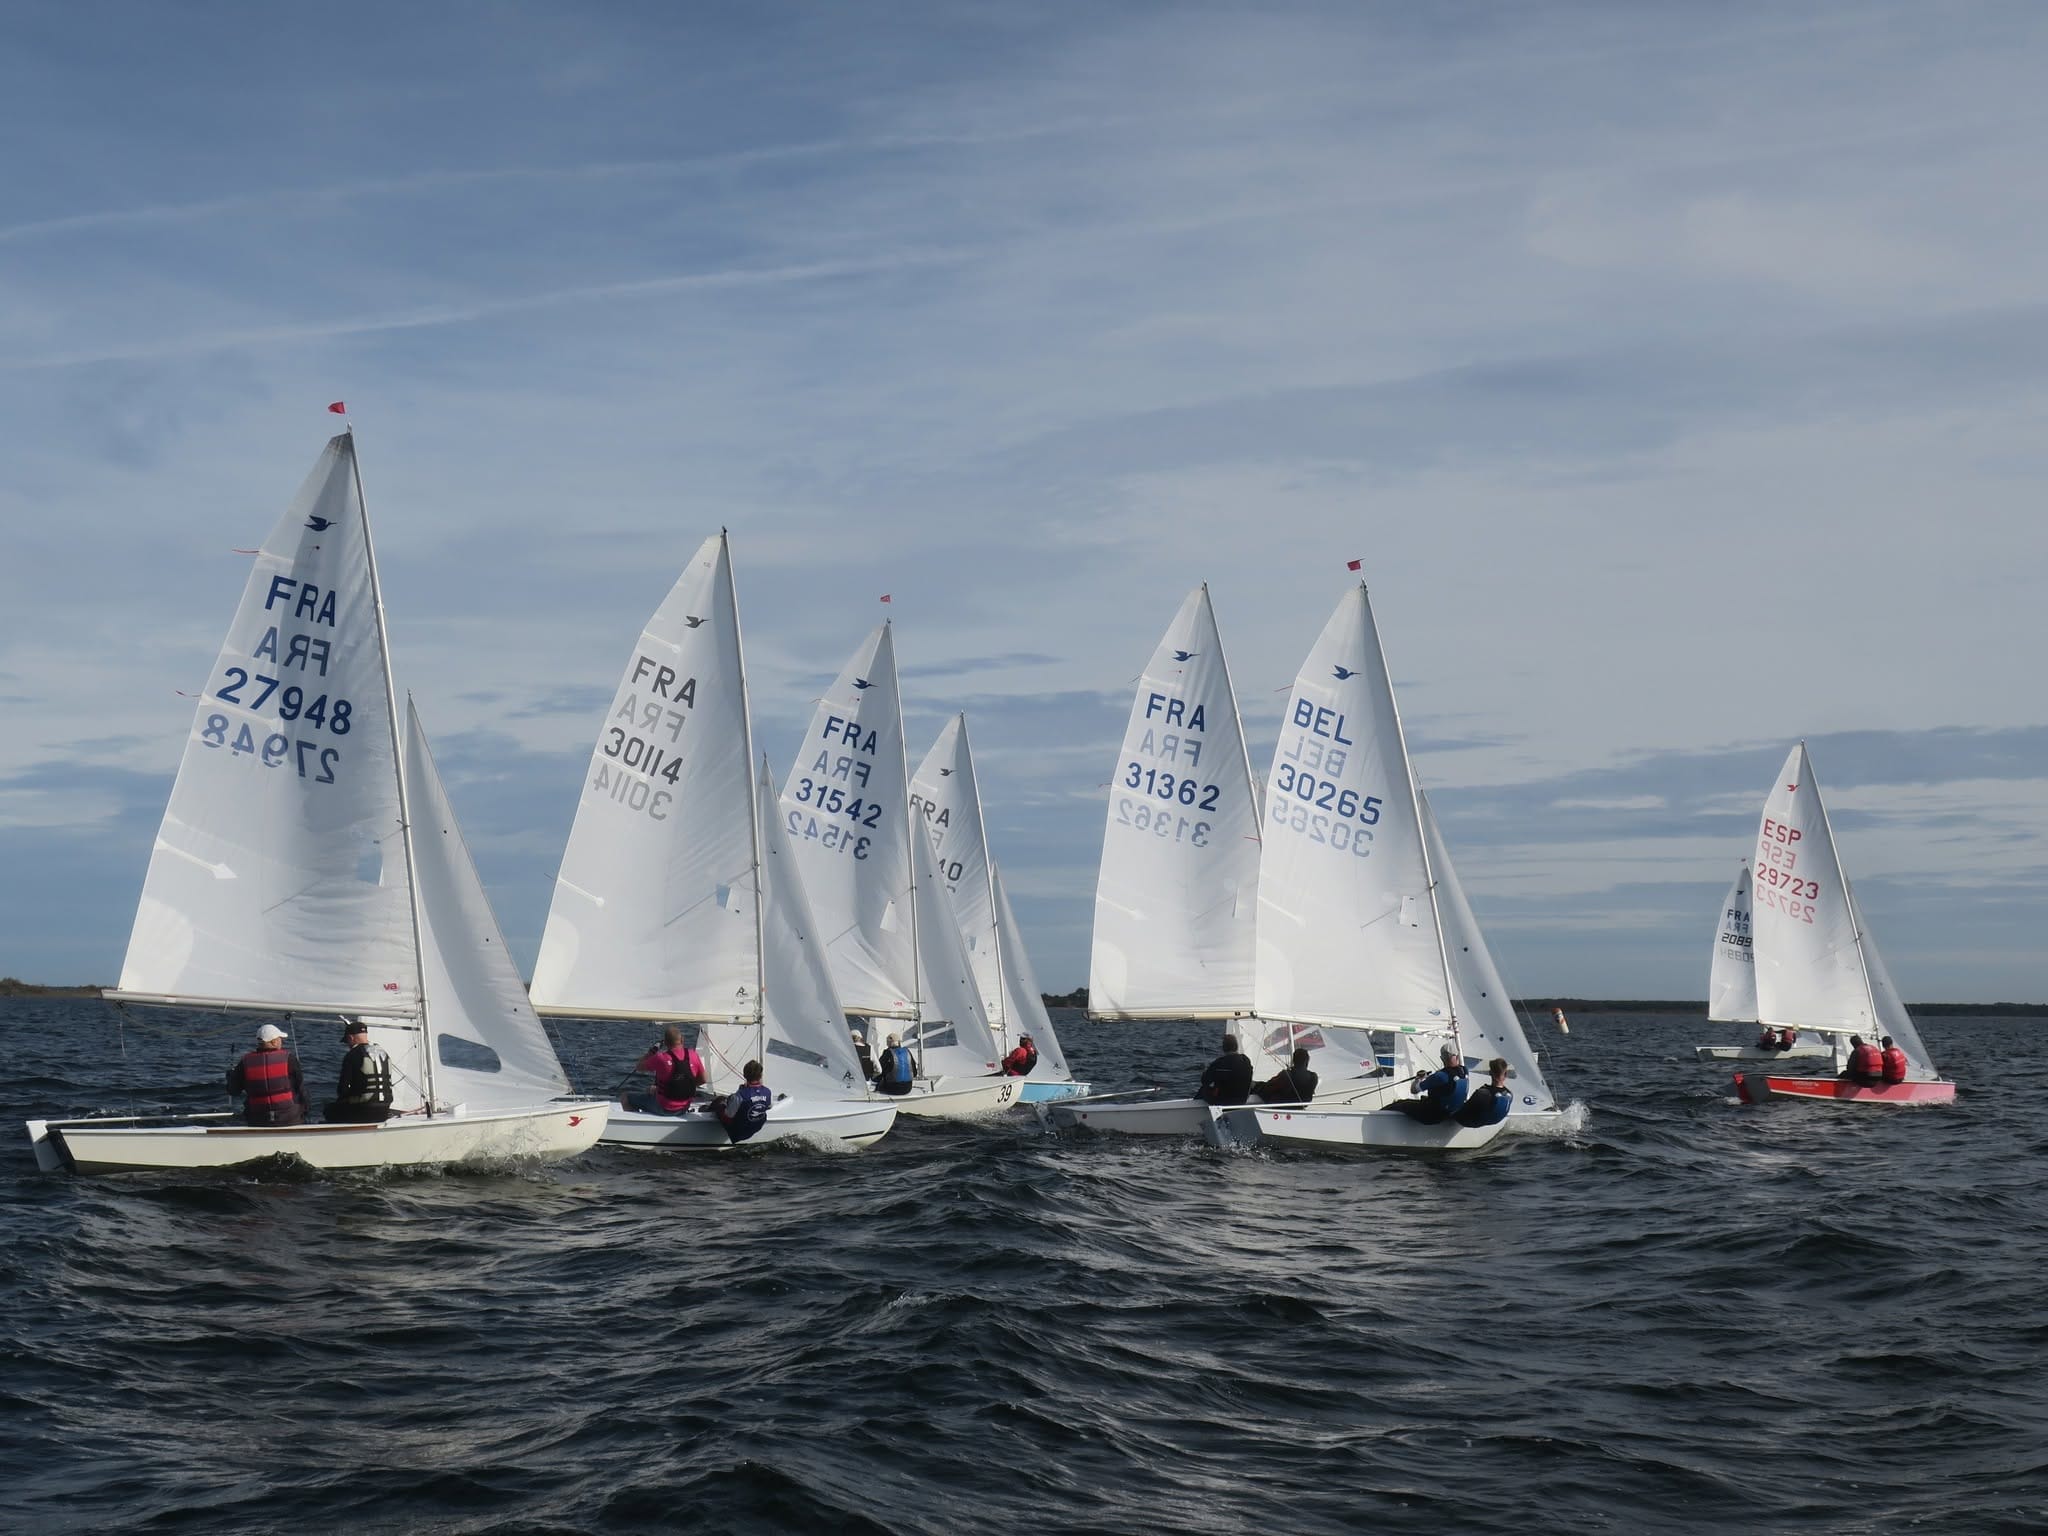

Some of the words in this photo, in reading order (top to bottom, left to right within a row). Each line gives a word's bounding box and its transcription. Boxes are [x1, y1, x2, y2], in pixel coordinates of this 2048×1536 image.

[265, 575, 335, 627] FRA
[216, 667, 352, 735] 27948
[631, 655, 697, 709] FRA
[1145, 692, 1205, 732] FRA
[1293, 697, 1353, 746] BEL
[604, 727, 683, 785] 30114
[822, 716, 877, 755] FRA
[795, 778, 882, 829] 31542
[1125, 762, 1220, 813] 31362
[1277, 763, 1383, 825] 30265
[909, 793, 950, 828] FRA
[1763, 818, 1802, 846] ESP
[1757, 862, 1819, 900] 29723
[1727, 908, 1750, 922] FRA
[1721, 932, 1753, 947] 2089
[997, 1084, 1012, 1103] 39
